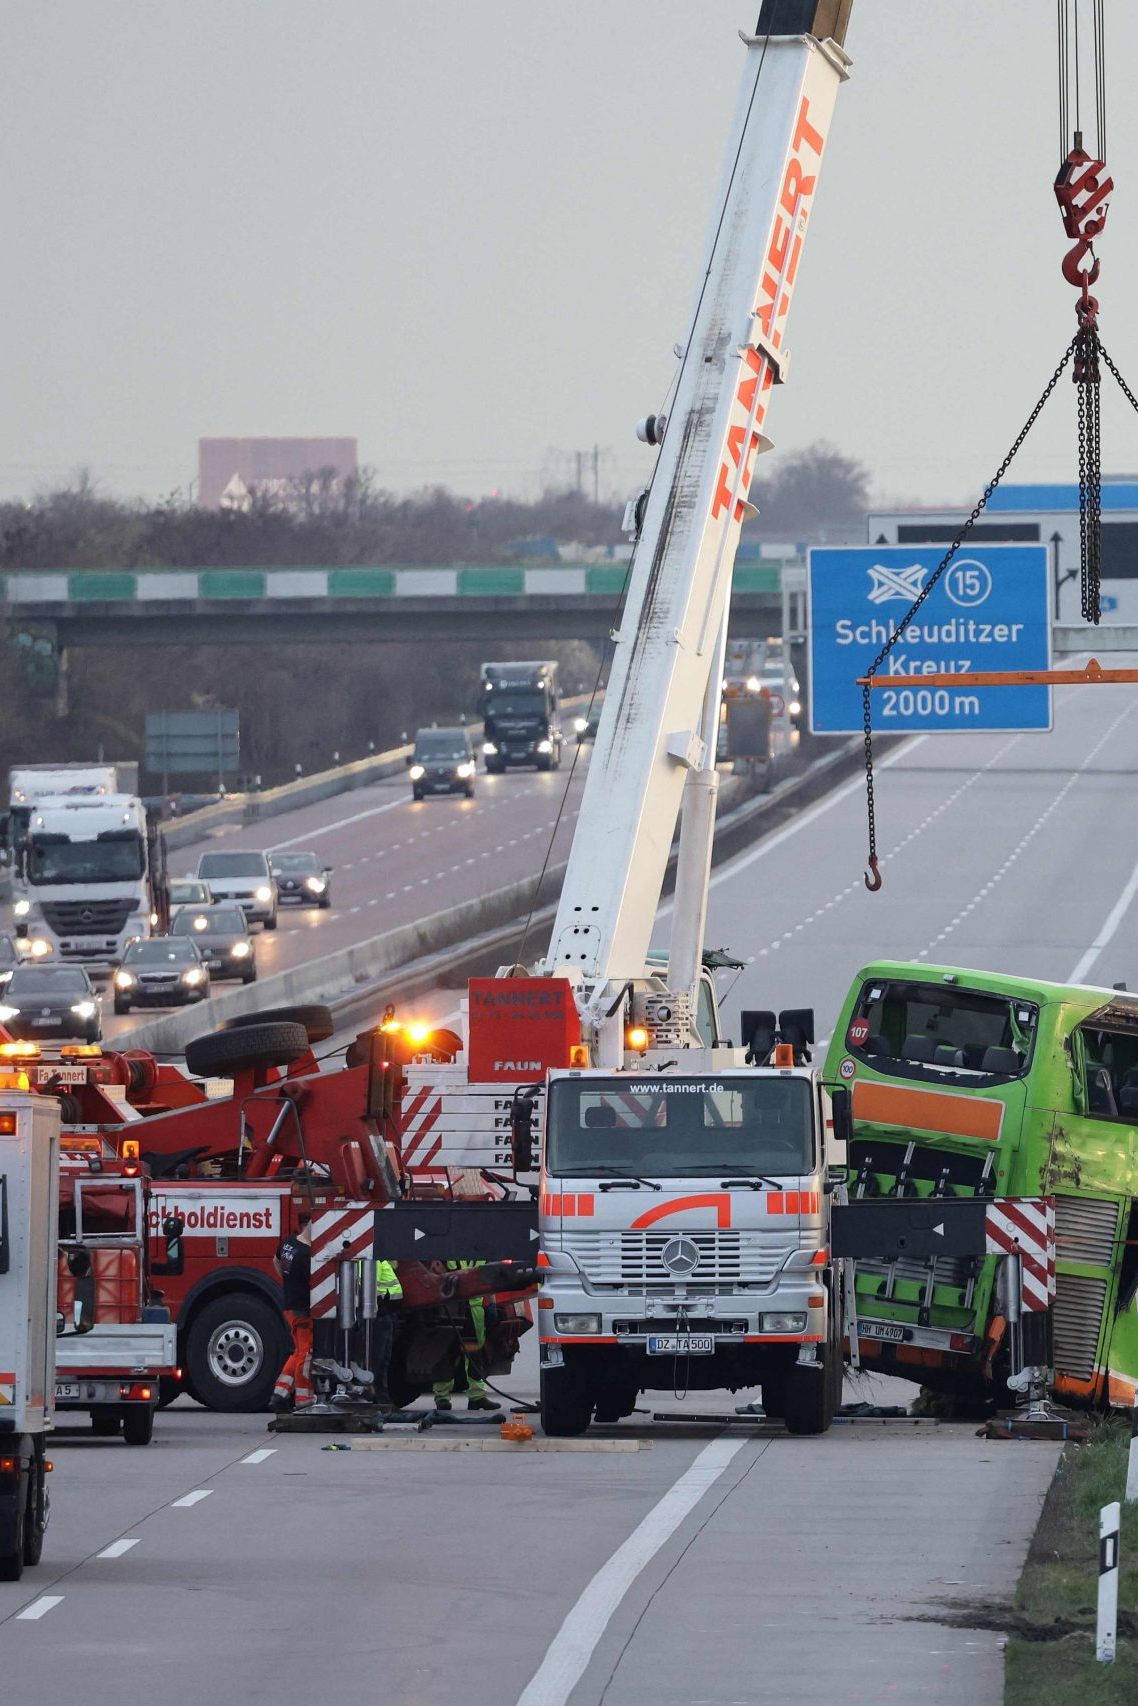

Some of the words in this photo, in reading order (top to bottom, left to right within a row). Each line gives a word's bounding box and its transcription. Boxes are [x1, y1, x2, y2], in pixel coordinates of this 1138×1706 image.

[711, 95, 824, 524] TANNERT
[954, 570, 980, 596] 15
[835, 619, 1024, 645] Schkeuditzer
[887, 655, 972, 676] Kreuz
[850, 1026, 869, 1039] 107
[493, 1060, 542, 1071] FAUN
[629, 1083, 724, 1093] www.tannert.de
[494, 1100, 539, 1110] FAN
[494, 1117, 539, 1127] FAN
[494, 1135, 539, 1145] FAN
[494, 1153, 539, 1163] FAN
